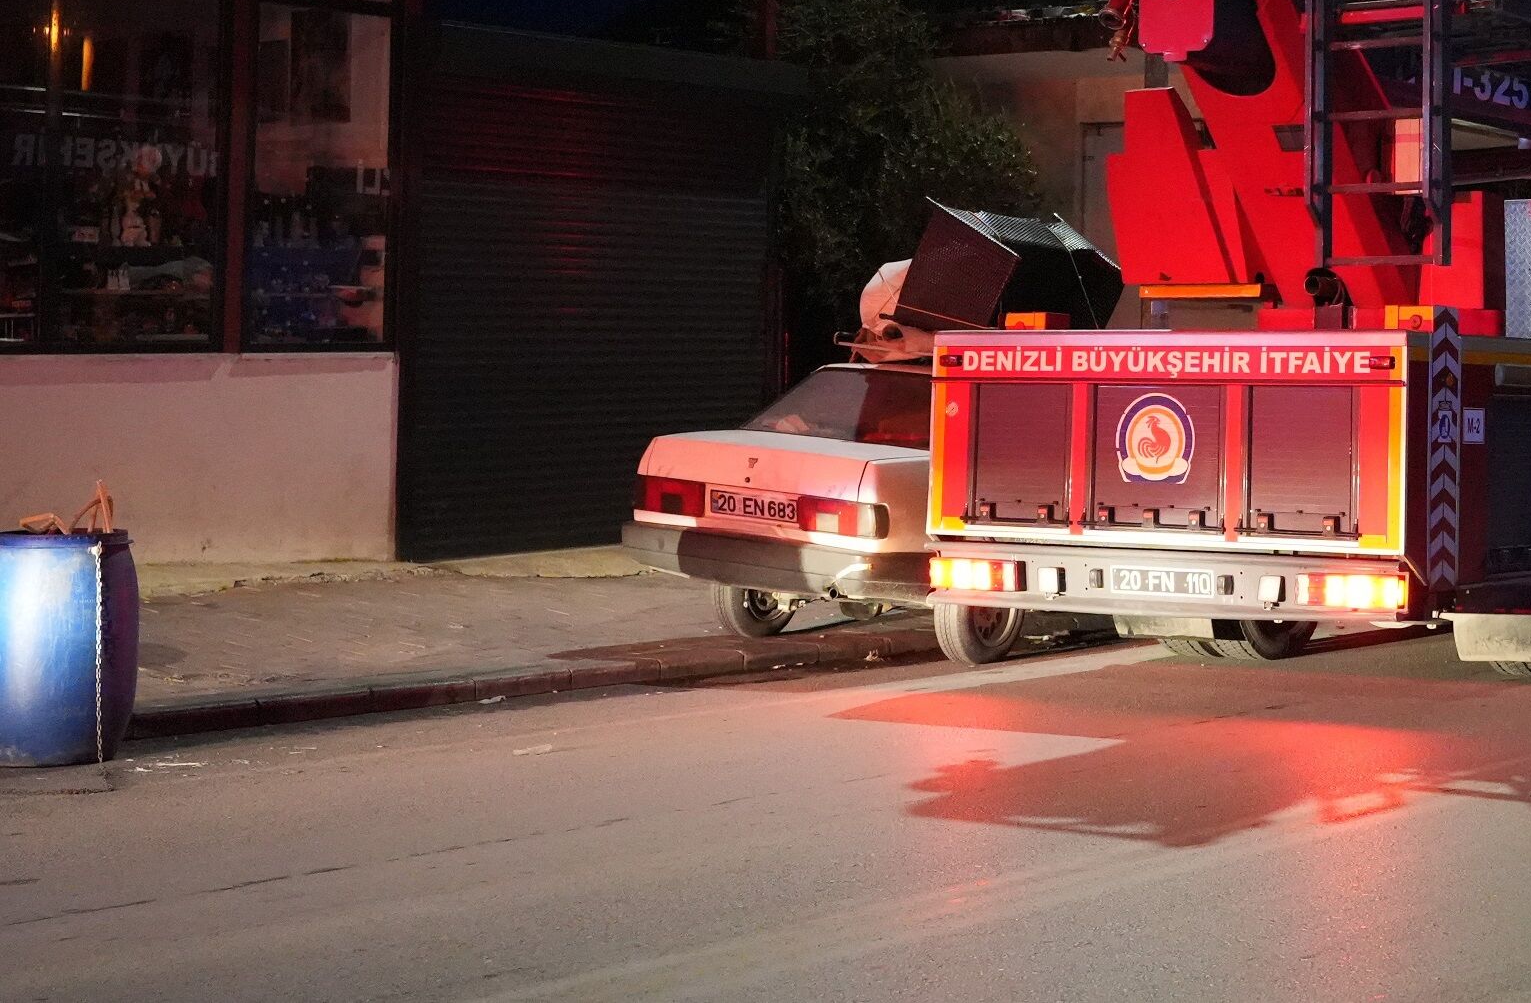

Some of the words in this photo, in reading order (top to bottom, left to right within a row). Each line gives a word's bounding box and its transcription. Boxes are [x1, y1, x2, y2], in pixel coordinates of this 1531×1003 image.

[963, 346, 1062, 372] DENİZLİ
[1071, 347, 1251, 379] BÜYÜKŞEHİR
[1259, 346, 1372, 375] İTFAİYE
[1467, 417, 1482, 434] M-2
[718, 494, 737, 513] 20
[743, 497, 765, 517] EN
[767, 500, 797, 521] 683
[1119, 570, 1142, 591] 20
[1147, 571, 1176, 593] FN
[1186, 572, 1212, 595] 110
